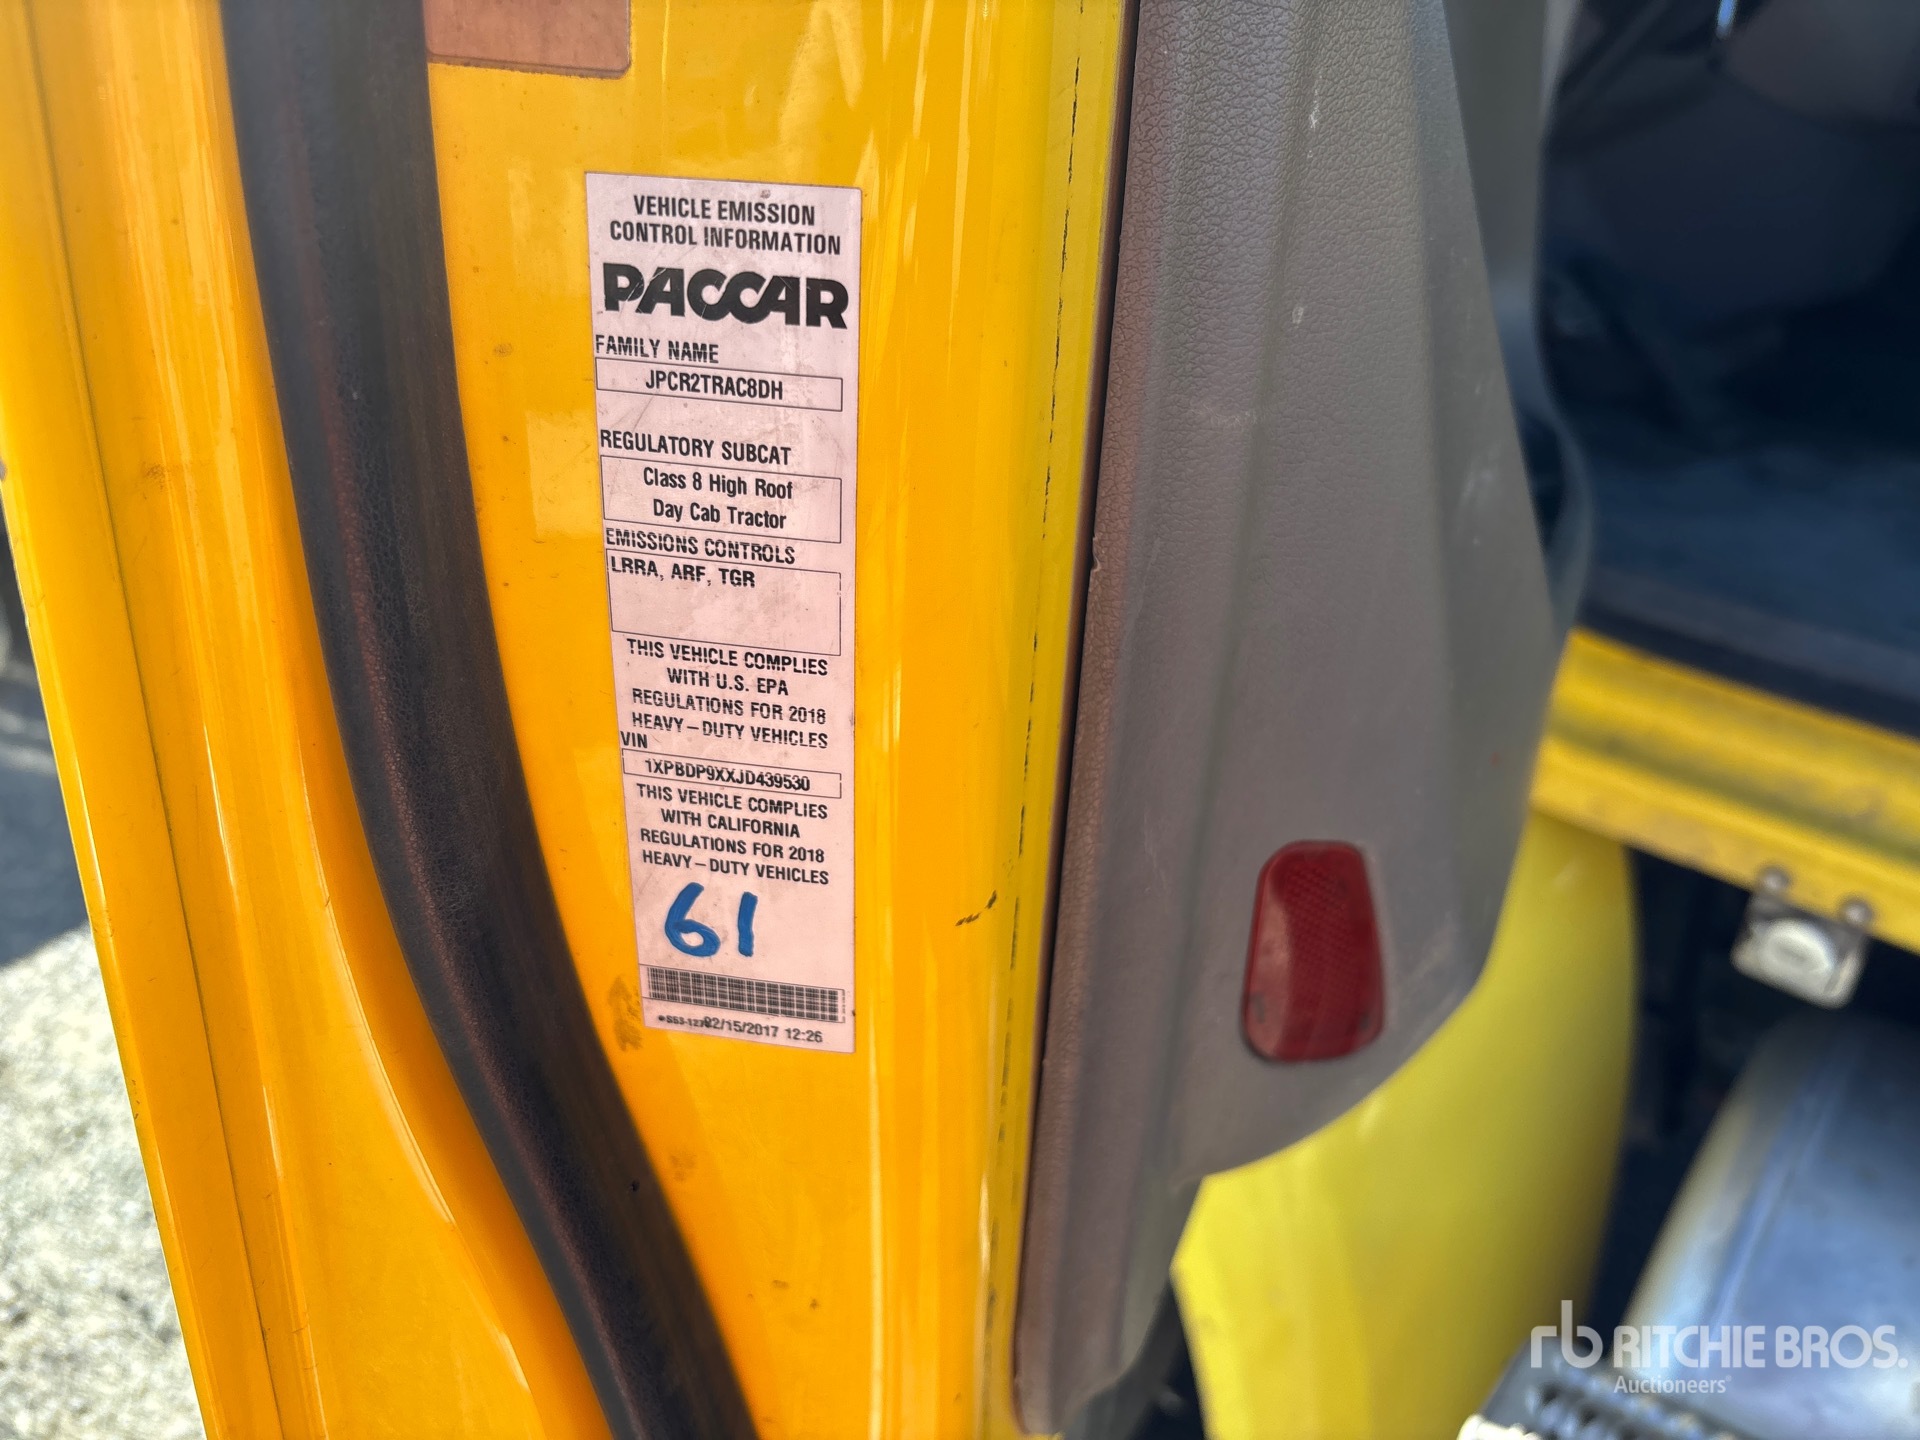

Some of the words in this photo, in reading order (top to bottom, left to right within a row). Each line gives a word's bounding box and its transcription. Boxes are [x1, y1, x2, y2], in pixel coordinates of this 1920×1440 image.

[634, 195, 711, 220] VEHICLE
[718, 200, 815, 226] EMISSION
[610, 220, 697, 246] CONTROL
[704, 226, 841, 255] INFORMATION
[603, 262, 849, 330] PACCAR
[595, 334, 660, 359] FAMILY
[668, 340, 719, 364] NAME
[646, 370, 783, 400] JPCR2TRAC8DH
[600, 429, 714, 458] REGULATORY
[722, 440, 791, 465] SUBCAT
[643, 467, 687, 490] Class
[692, 472, 702, 491] 8
[709, 474, 747, 497] High
[755, 479, 793, 499] Roof
[653, 499, 683, 522] Day
[690, 503, 720, 523] Cab
[727, 506, 786, 529] Tractor
[606, 528, 698, 554] EMISSIONS
[704, 538, 796, 565] CONTROLS
[611, 556, 664, 581] LRRA,
[718, 568, 755, 588] TGR
[627, 638, 664, 658] THIS
[670, 643, 738, 667] VEHICLE
[744, 652, 828, 676] COMPLIES
[667, 667, 710, 688] WITH
[716, 674, 749, 692] U.S.
[757, 678, 789, 696] EPA
[632, 688, 744, 717] REGULATIONS
[751, 701, 783, 721] FOR
[788, 706, 826, 725] 2018
[620, 731, 648, 749] VIN
[751, 726, 828, 749] VEHICLES
[644, 758, 810, 791] 1XPBDP9XXJD439530
[637, 783, 673, 802] THIS
[678, 788, 742, 811] VEHICLE
[748, 796, 828, 820] COMPLIES
[661, 808, 702, 827] WITH
[708, 815, 801, 838] CALIFORNIA
[640, 828, 747, 855] REGULATIONS
[753, 842, 784, 859] FOR
[789, 846, 825, 864] 2018
[755, 864, 829, 885] VEHICLES
[664, 882, 758, 957] 61
[785, 1028, 823, 1043] 12:26
